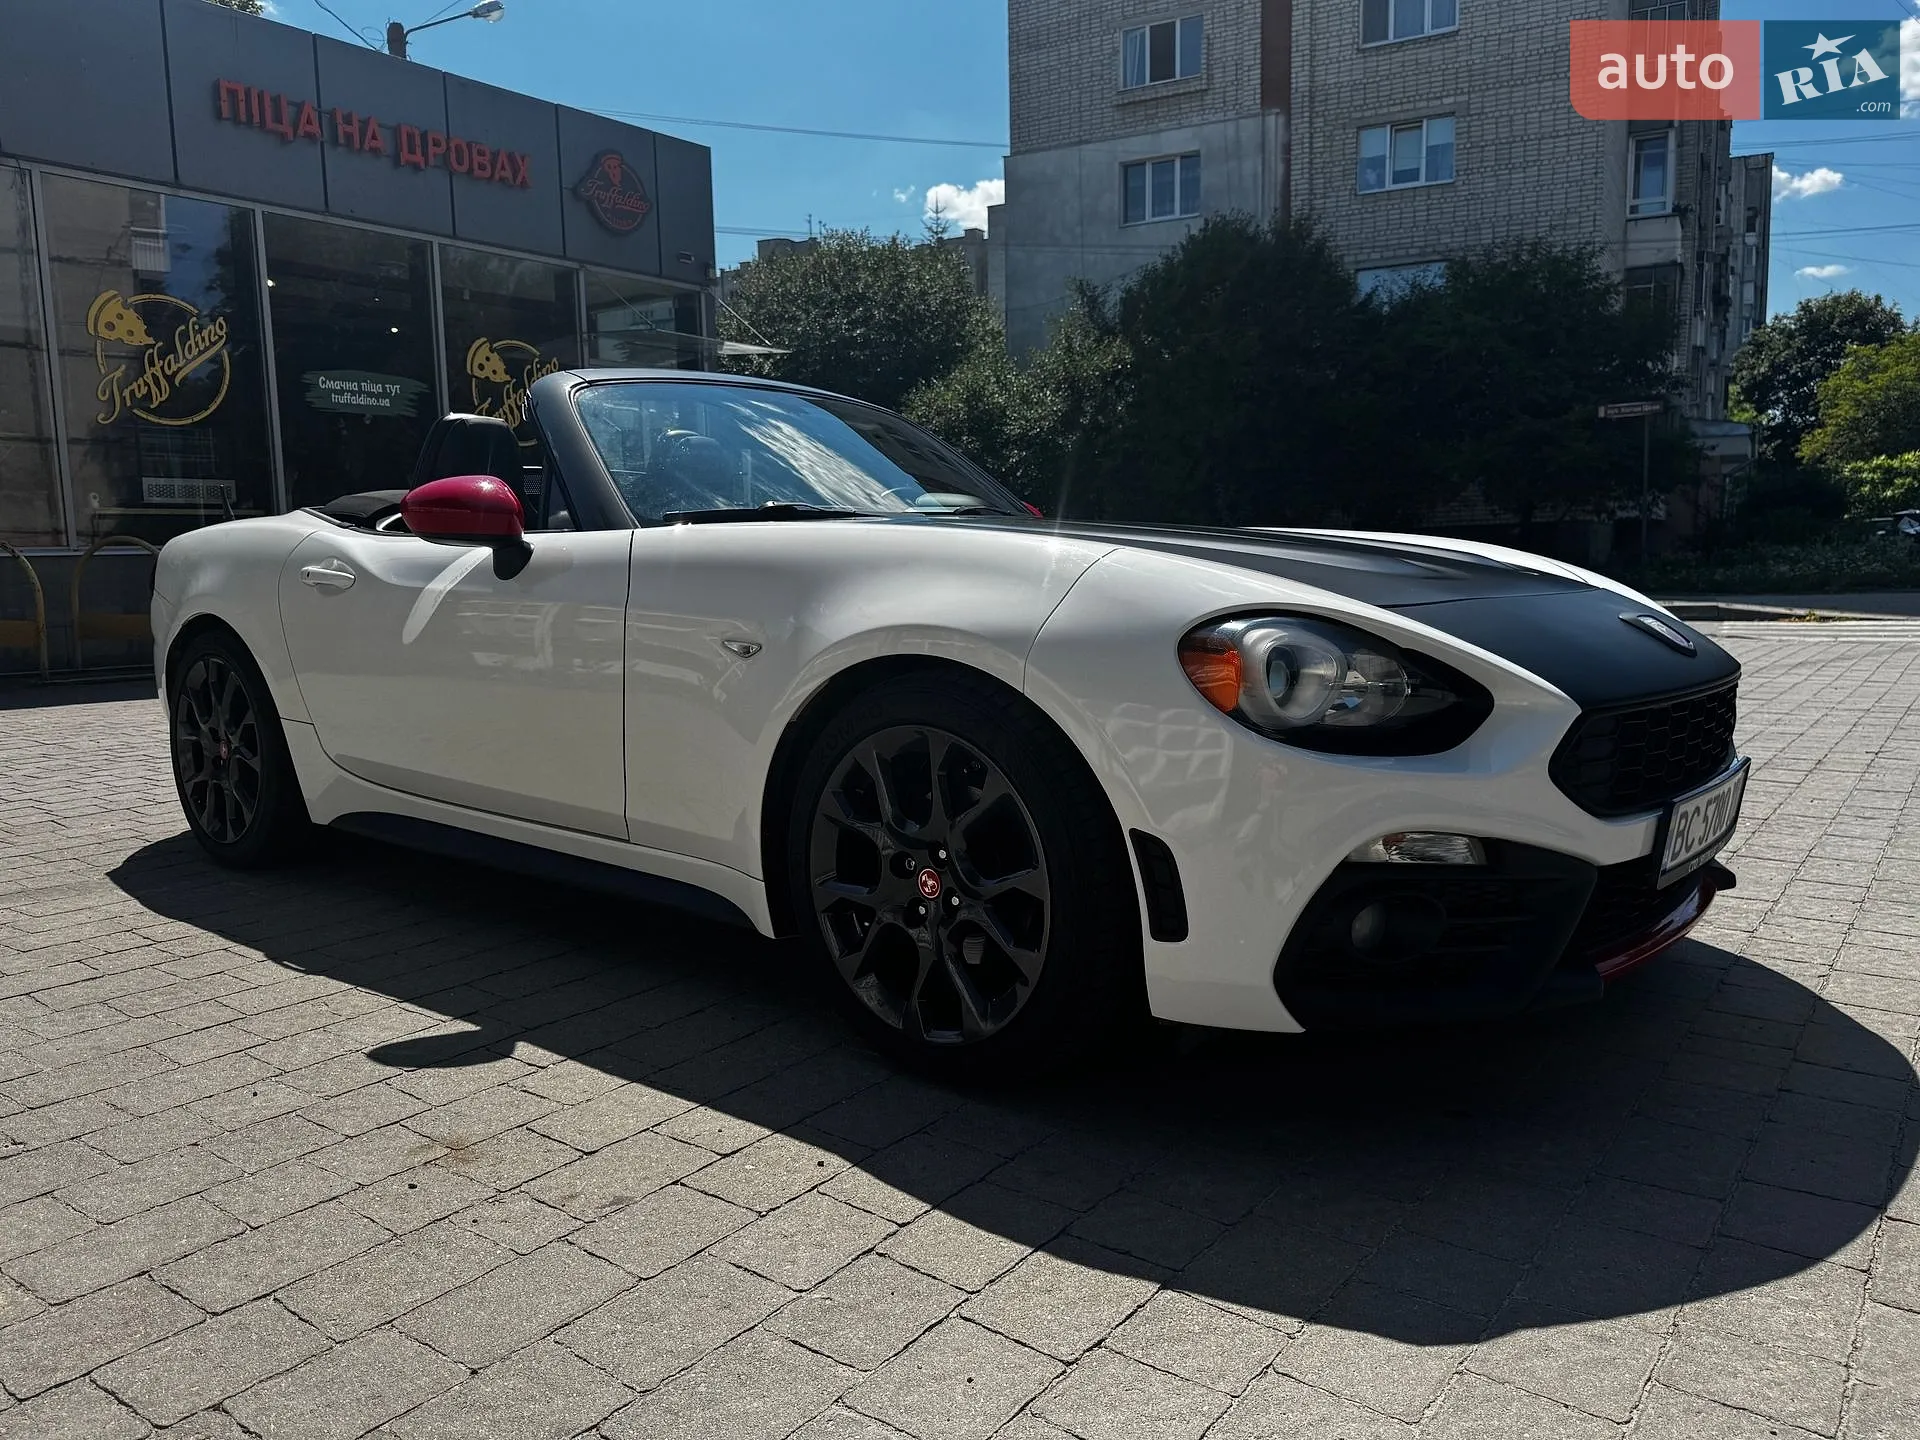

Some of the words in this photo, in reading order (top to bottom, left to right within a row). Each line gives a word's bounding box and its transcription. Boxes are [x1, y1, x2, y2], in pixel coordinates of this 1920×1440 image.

[216, 78, 323, 142] ПІЦА
[334, 107, 387, 154] НА
[395, 121, 532, 189] ДРОВАХ
[97, 316, 227, 425] Truffaldino
[318, 376, 359, 391] Смачна
[361, 380, 383, 394] піца
[385, 383, 401, 397] тут
[331, 392, 391, 407] truffaldino.ua
